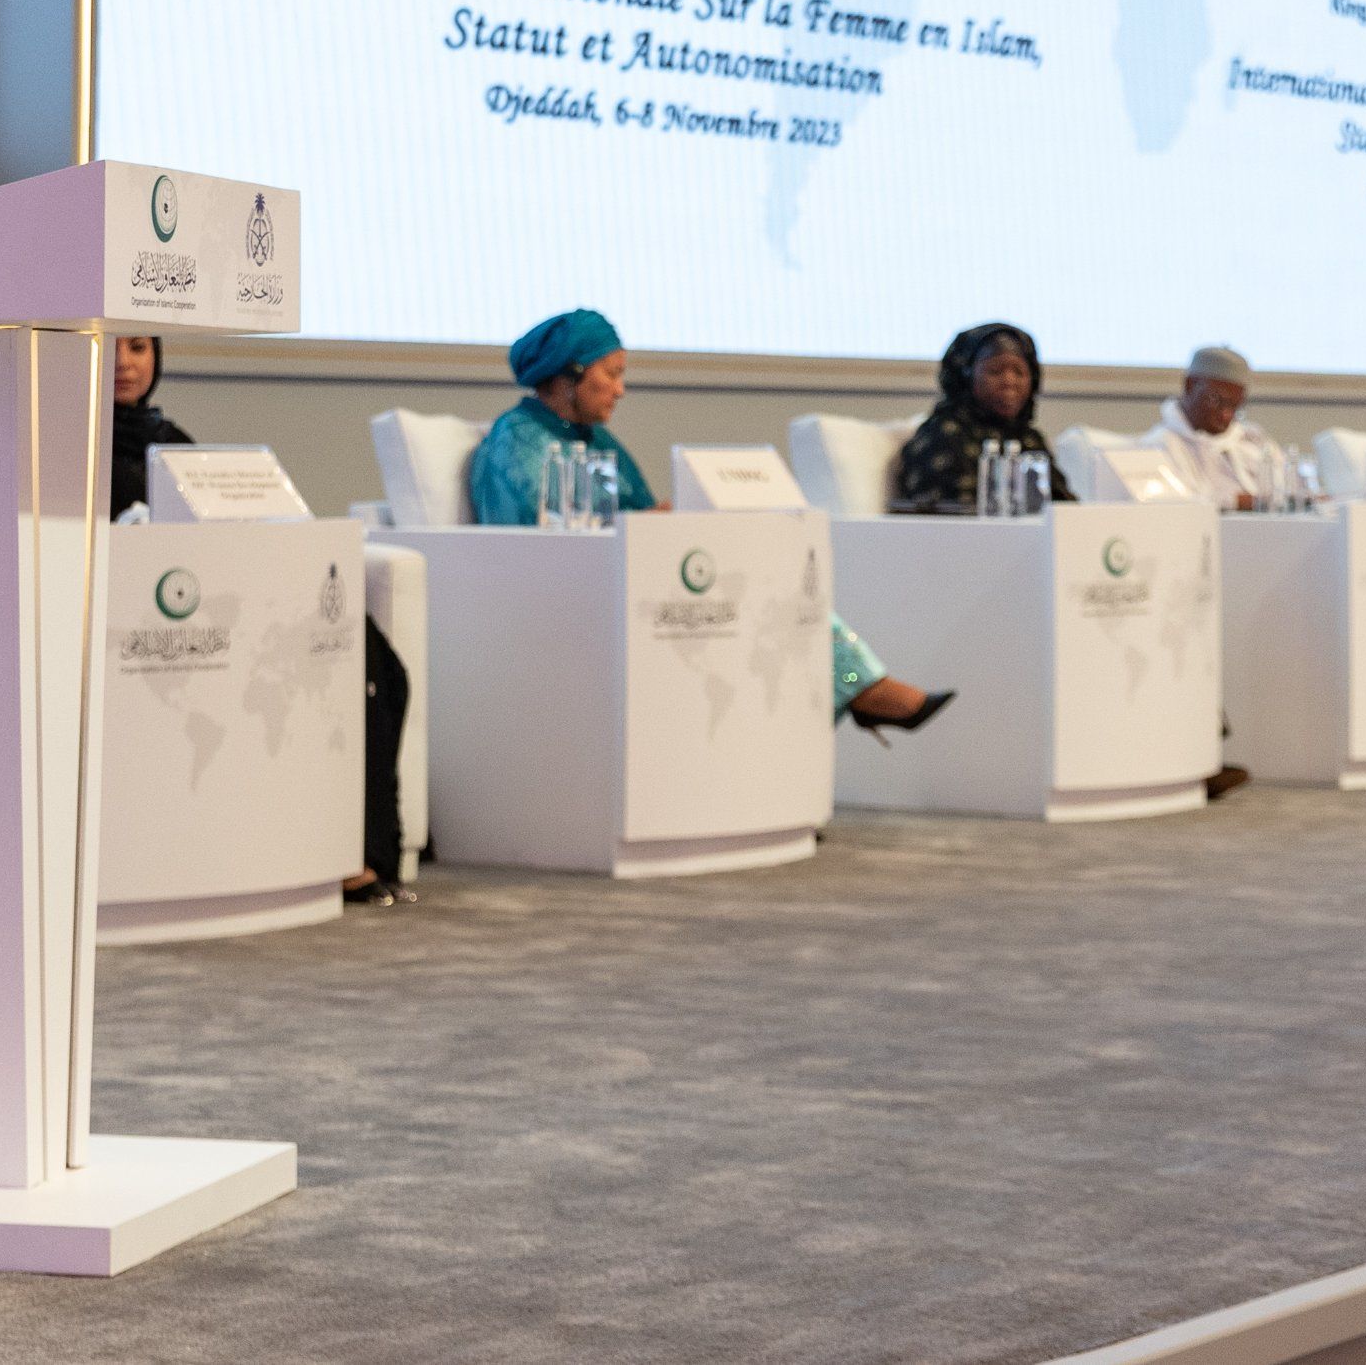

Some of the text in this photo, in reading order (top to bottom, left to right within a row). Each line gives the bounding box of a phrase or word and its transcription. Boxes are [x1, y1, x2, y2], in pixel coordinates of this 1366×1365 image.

[444, 7, 884, 95] Statut et Autonomisation
[919, 22, 950, 50] en
[961, 17, 1043, 67] Islam,
[485, 83, 844, 149] Djeddah, 6-8 Novembre 2023
